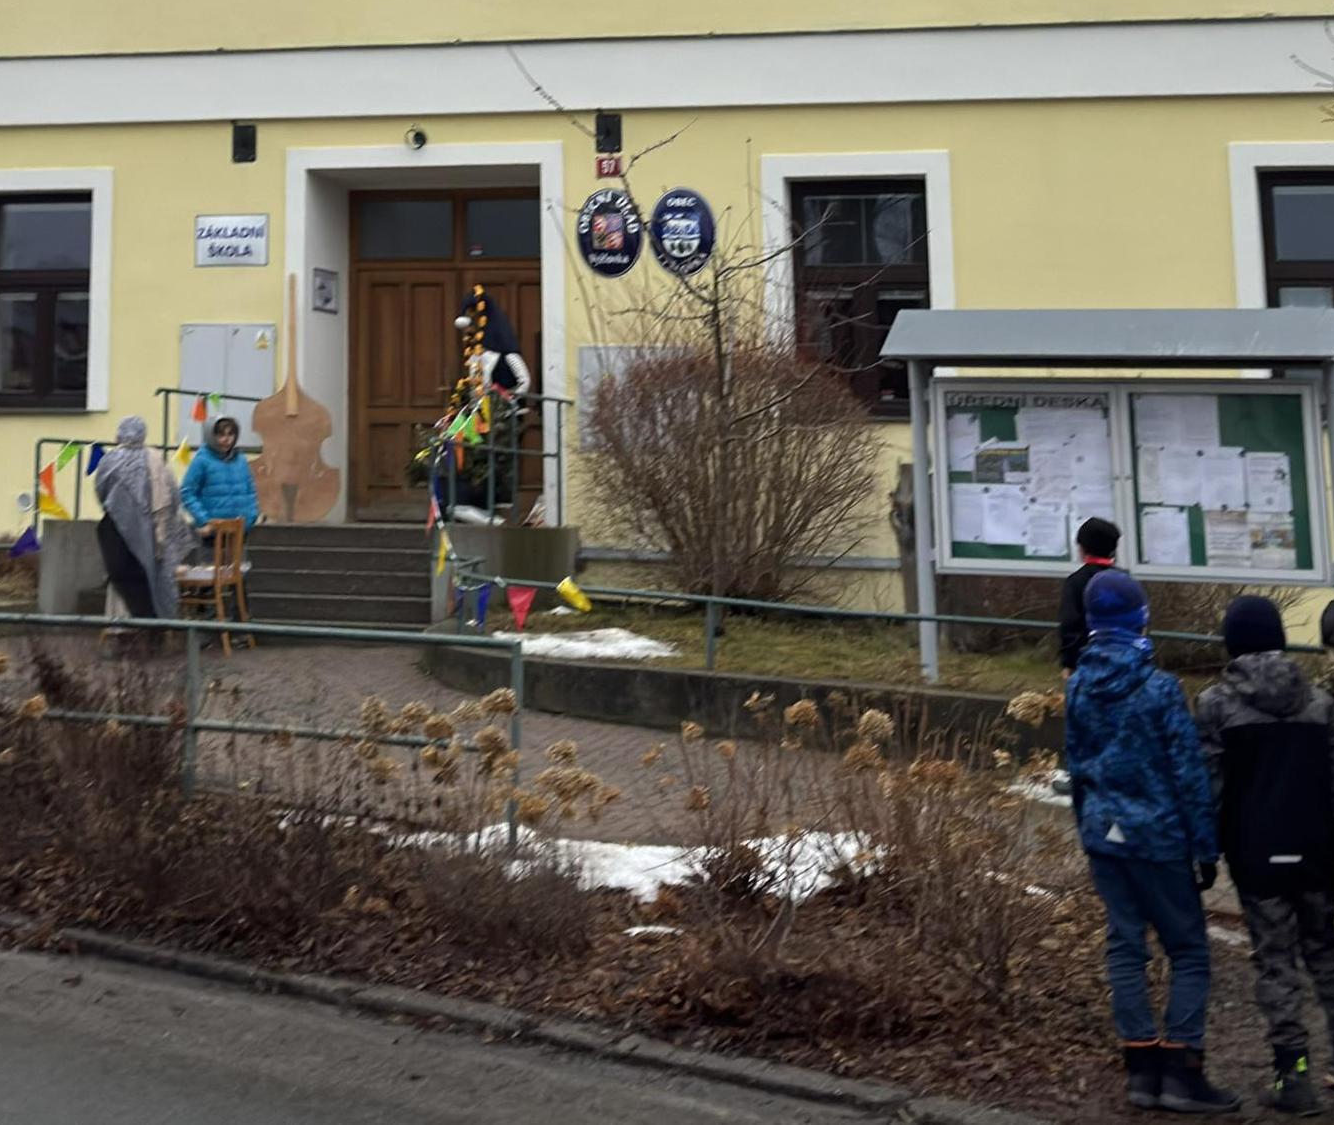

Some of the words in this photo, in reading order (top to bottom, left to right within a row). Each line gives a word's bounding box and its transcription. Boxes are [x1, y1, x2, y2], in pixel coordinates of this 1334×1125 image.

[666, 197, 697, 208] OBEC
[578, 190, 613, 234] OBECNÍ
[197, 225, 265, 240] ZÁKLADNÍ
[207, 242, 253, 258] ŠKOLA
[1033, 394, 1103, 409] DESKA
